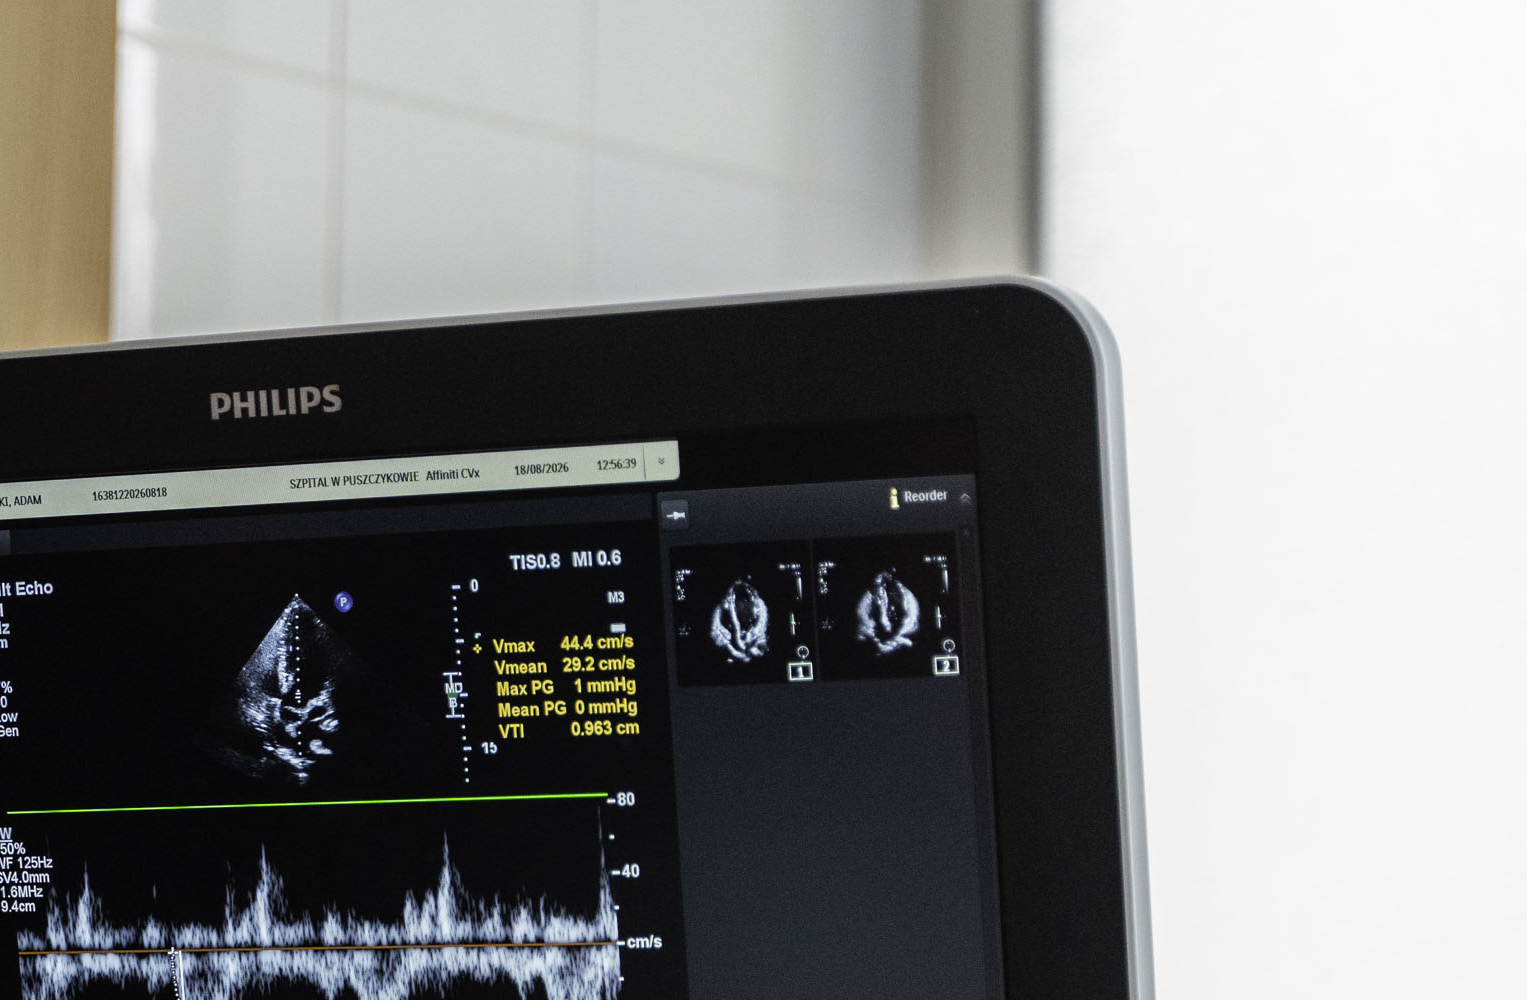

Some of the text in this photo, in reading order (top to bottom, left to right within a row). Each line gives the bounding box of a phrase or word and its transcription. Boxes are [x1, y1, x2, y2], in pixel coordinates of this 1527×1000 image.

[210, 384, 342, 420] PHILIPS
[289, 458, 637, 490] SZPITAL W PUSZCZYKOWIE Affiniti CVx 18/08/2026 12:56:39
[14, 495, 42, 506] ADAM
[92, 487, 167, 501] 16381220260818
[905, 490, 948, 502] Reorder
[510, 550, 621, 570] TIS0.8 MI 0.6
[15, 580, 53, 596] Echo
[469, 578, 479, 592] 0
[607, 591, 625, 604] M3
[493, 633, 634, 654] Vmax 44.4 cm/s
[494, 655, 635, 675] Vmean 29.2 cm/s
[497, 676, 637, 697] Max PG 1 mmHg
[498, 698, 638, 718] Mean PG 0 mmHg
[499, 720, 639, 739] VTI 0.963 cm
[481, 741, 498, 754] 15
[0, 842, 26, 855] 50%
[17, 856, 53, 869] 125Hz
[1, 885, 44, 898] 1.6MHz
[1, 900, 36, 913] 9.4cm
[627, 935, 663, 949] cm/s
